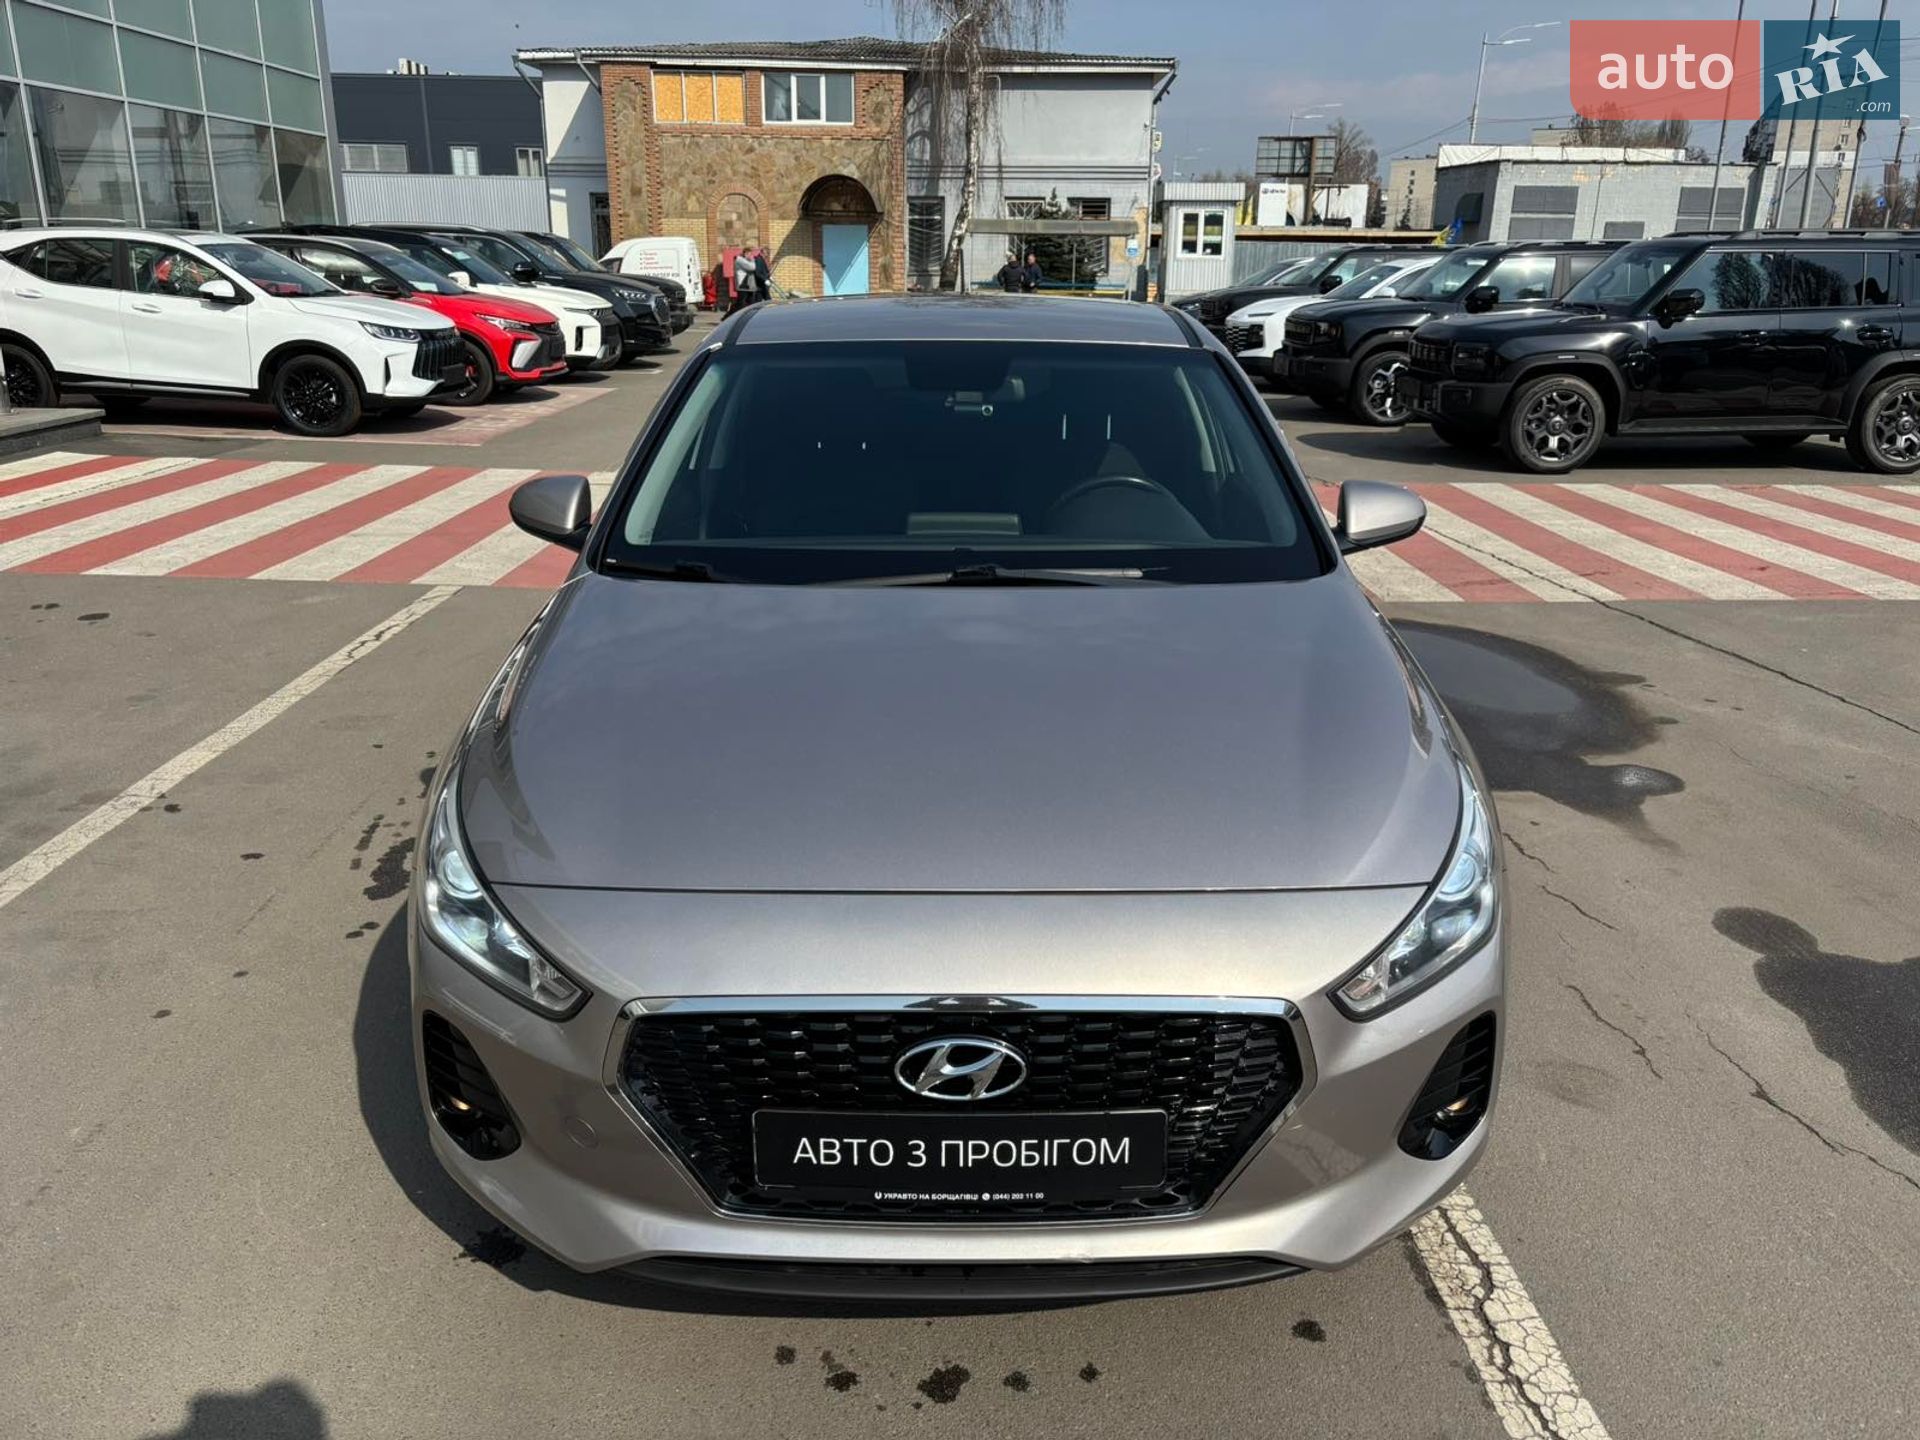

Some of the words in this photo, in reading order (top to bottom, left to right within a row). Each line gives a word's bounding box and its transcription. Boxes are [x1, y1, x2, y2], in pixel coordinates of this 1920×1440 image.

[793, 1137, 895, 1167] АВТО
[940, 1136, 1130, 1168] ПРОБІГОМ
[918, 1192, 931, 1201] НА
[1025, 1191, 1034, 1200] 11
